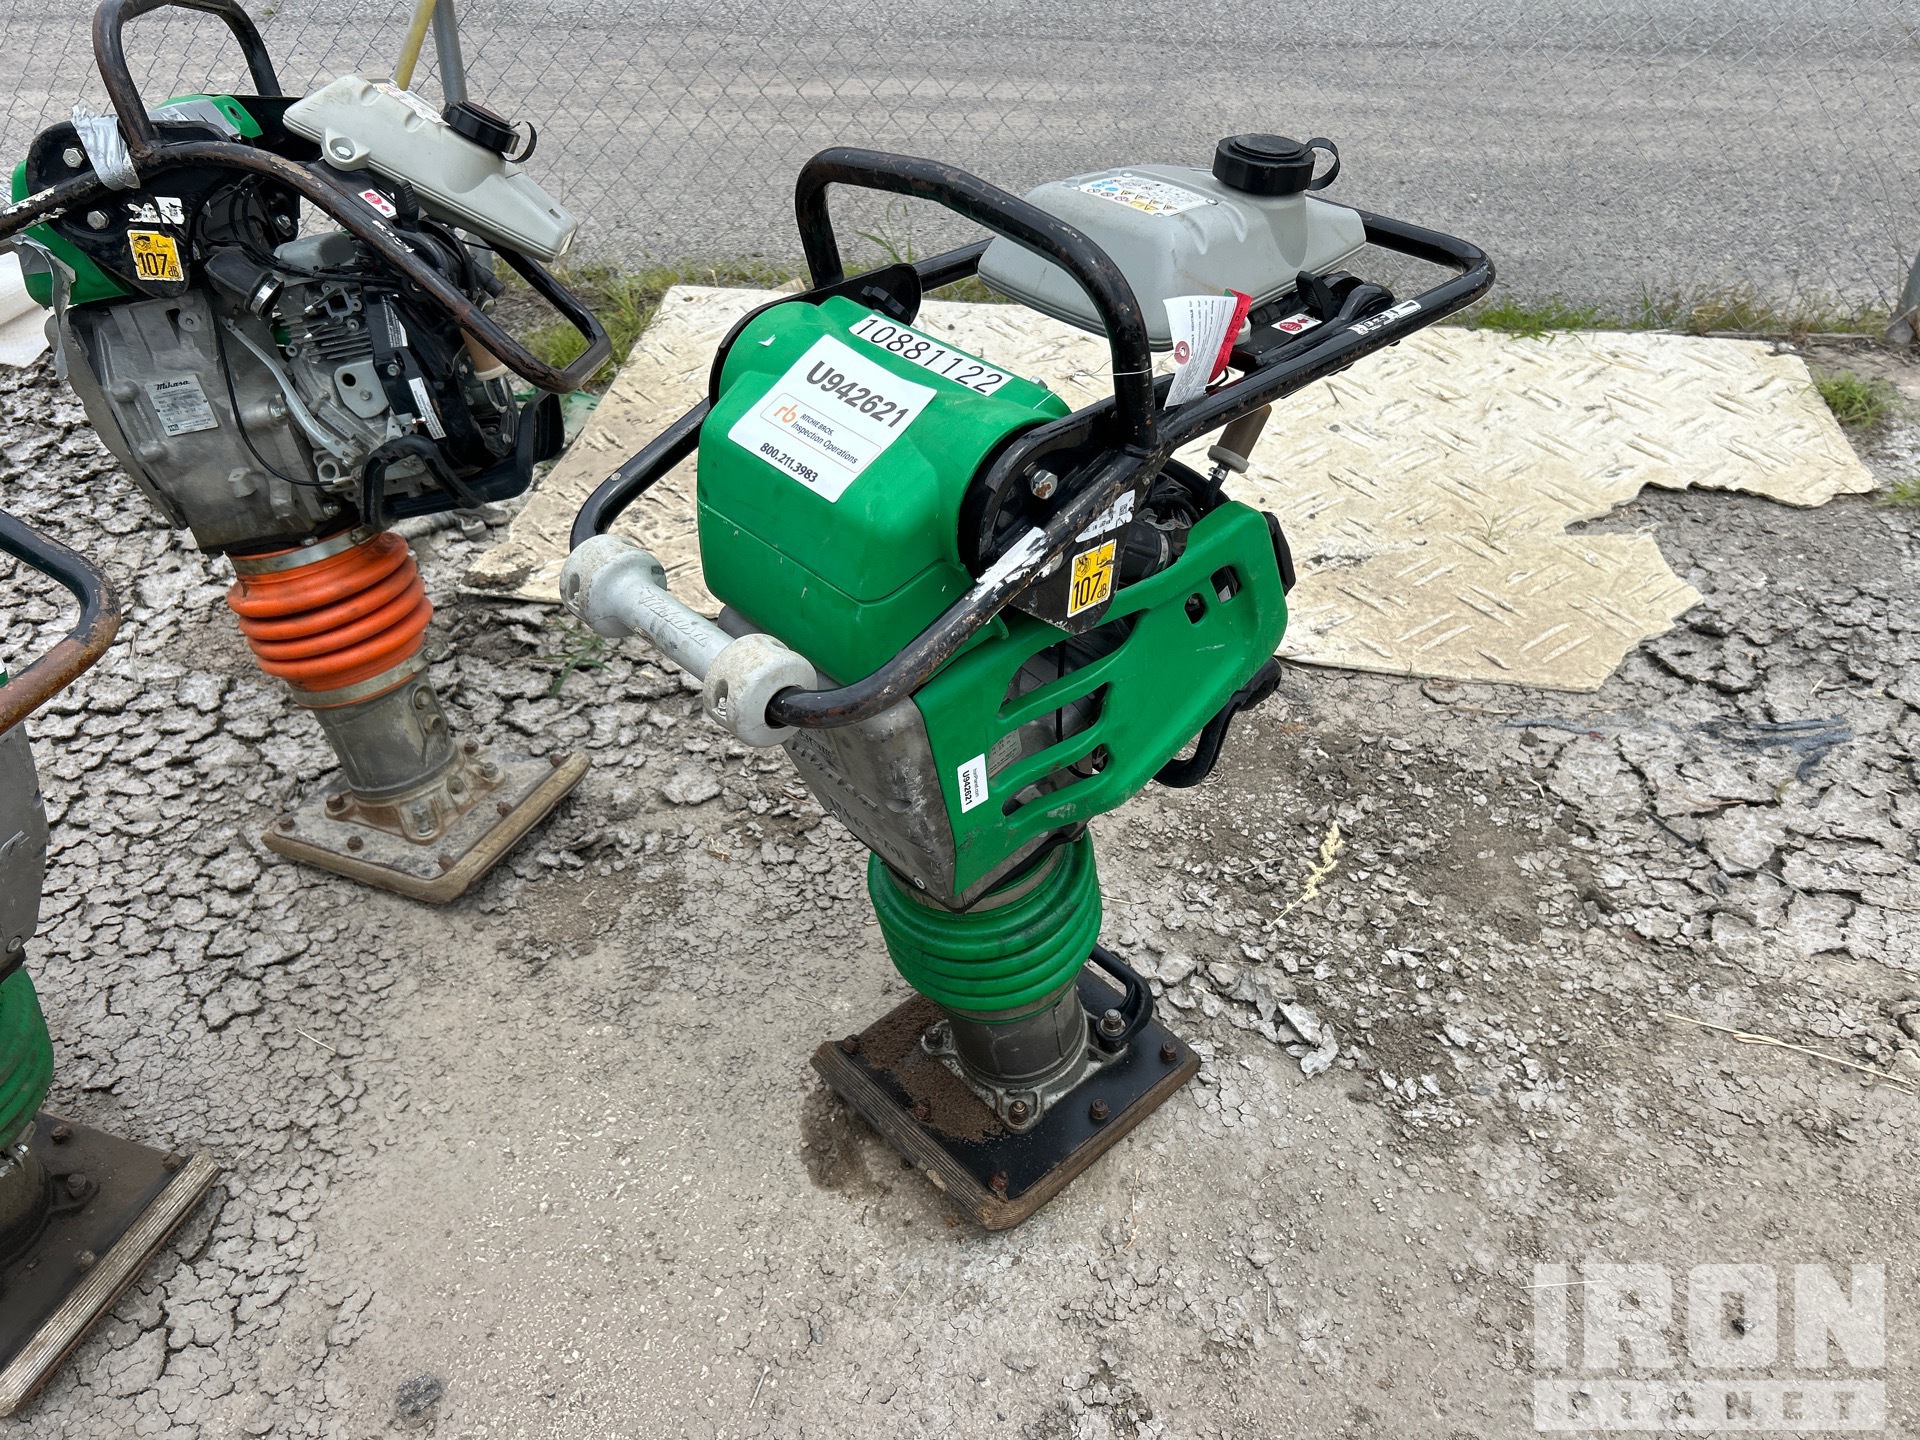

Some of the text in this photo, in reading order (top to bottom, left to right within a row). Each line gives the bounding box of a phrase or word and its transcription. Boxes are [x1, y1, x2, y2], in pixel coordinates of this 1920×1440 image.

[138, 252, 168, 276] 107
[856, 318, 1003, 394] 10881122
[154, 380, 190, 391] Mikasa
[805, 360, 909, 429] U942621
[773, 403, 798, 424] rb
[800, 413, 835, 437] RITCHIE BROS.
[790, 420, 859, 465] Inspection Operations
[759, 442, 819, 483] 800.211.3983
[1073, 570, 1107, 609] 107 dB
[639, 591, 709, 648] Mikasa
[962, 769, 973, 806] U942621
